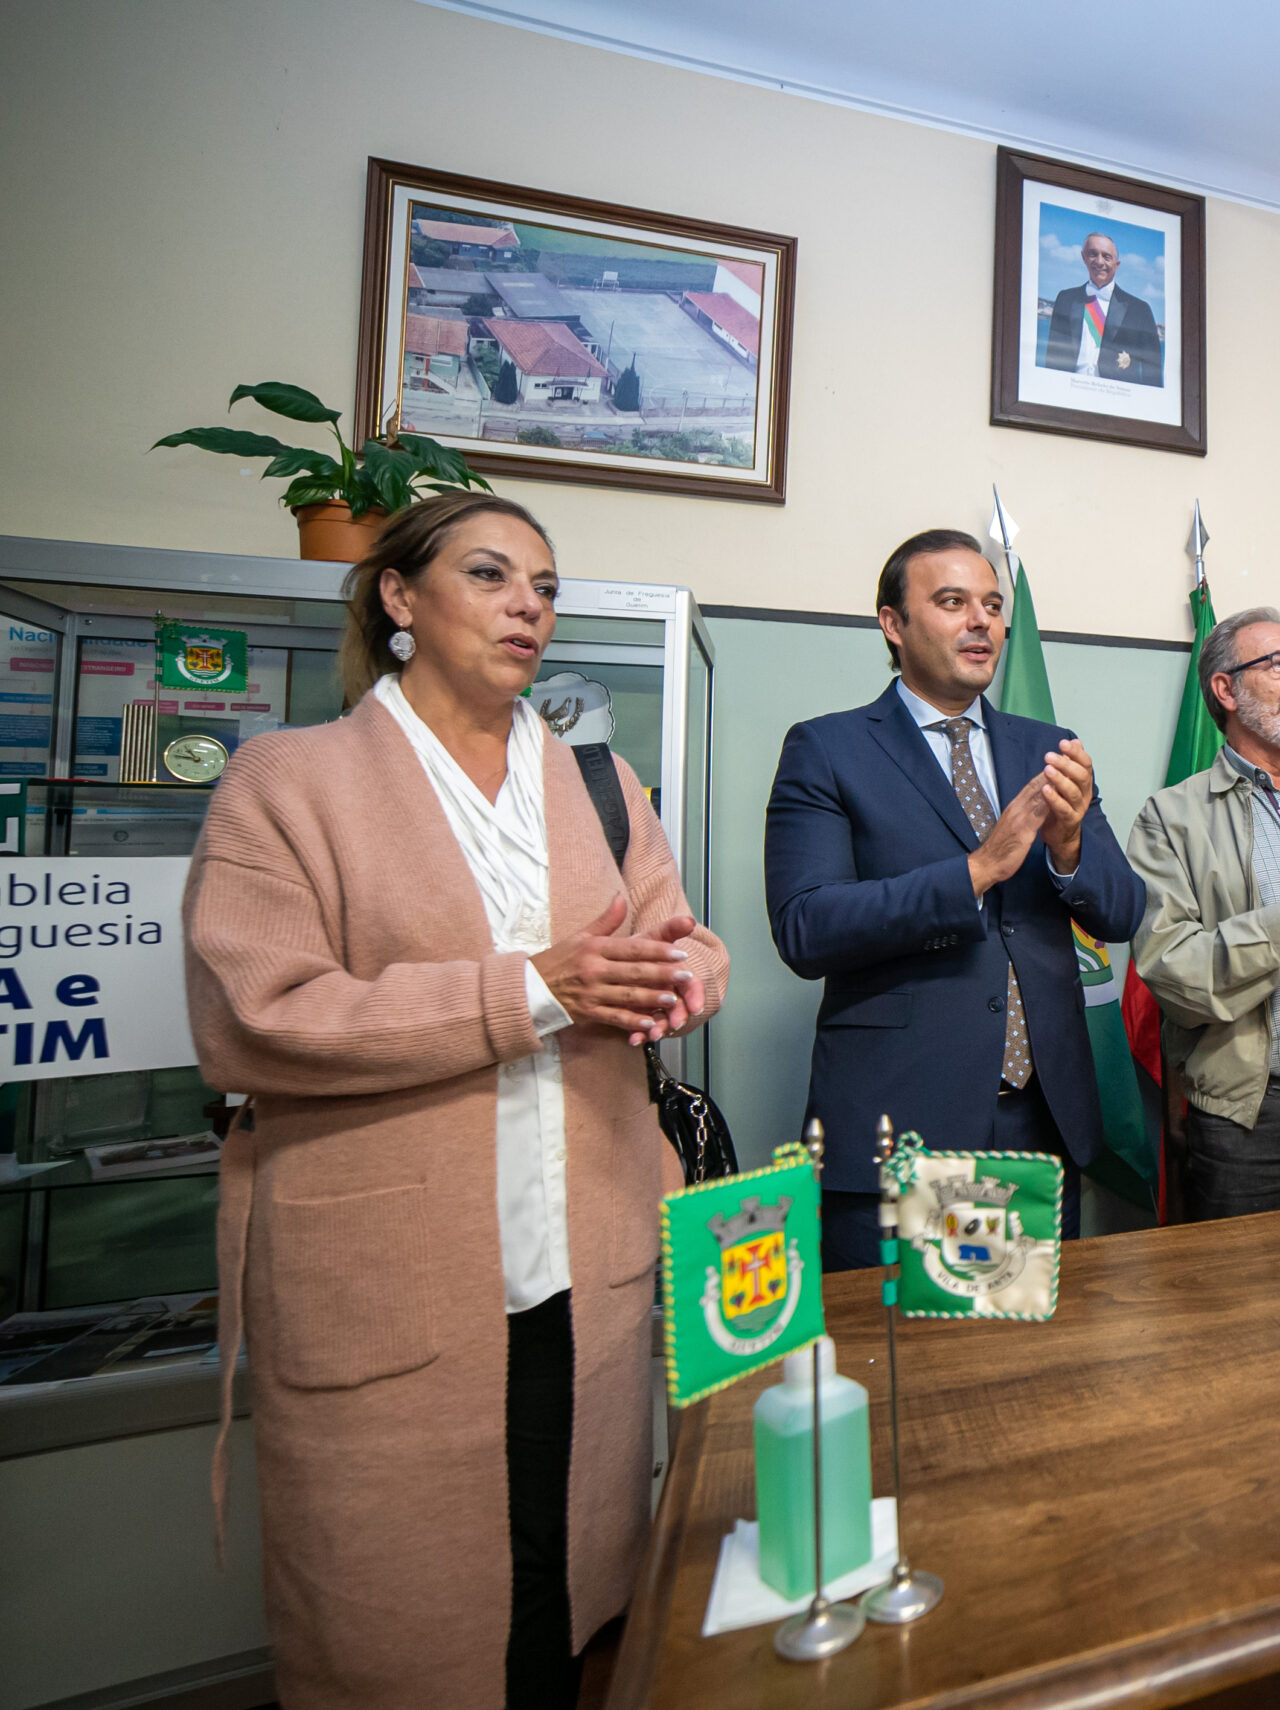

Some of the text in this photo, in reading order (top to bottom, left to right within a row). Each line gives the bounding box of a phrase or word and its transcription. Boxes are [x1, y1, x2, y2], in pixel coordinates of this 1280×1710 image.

[0, 872, 132, 907] bleia
[56, 973, 101, 1007] e
[0, 1016, 110, 1066] IM
